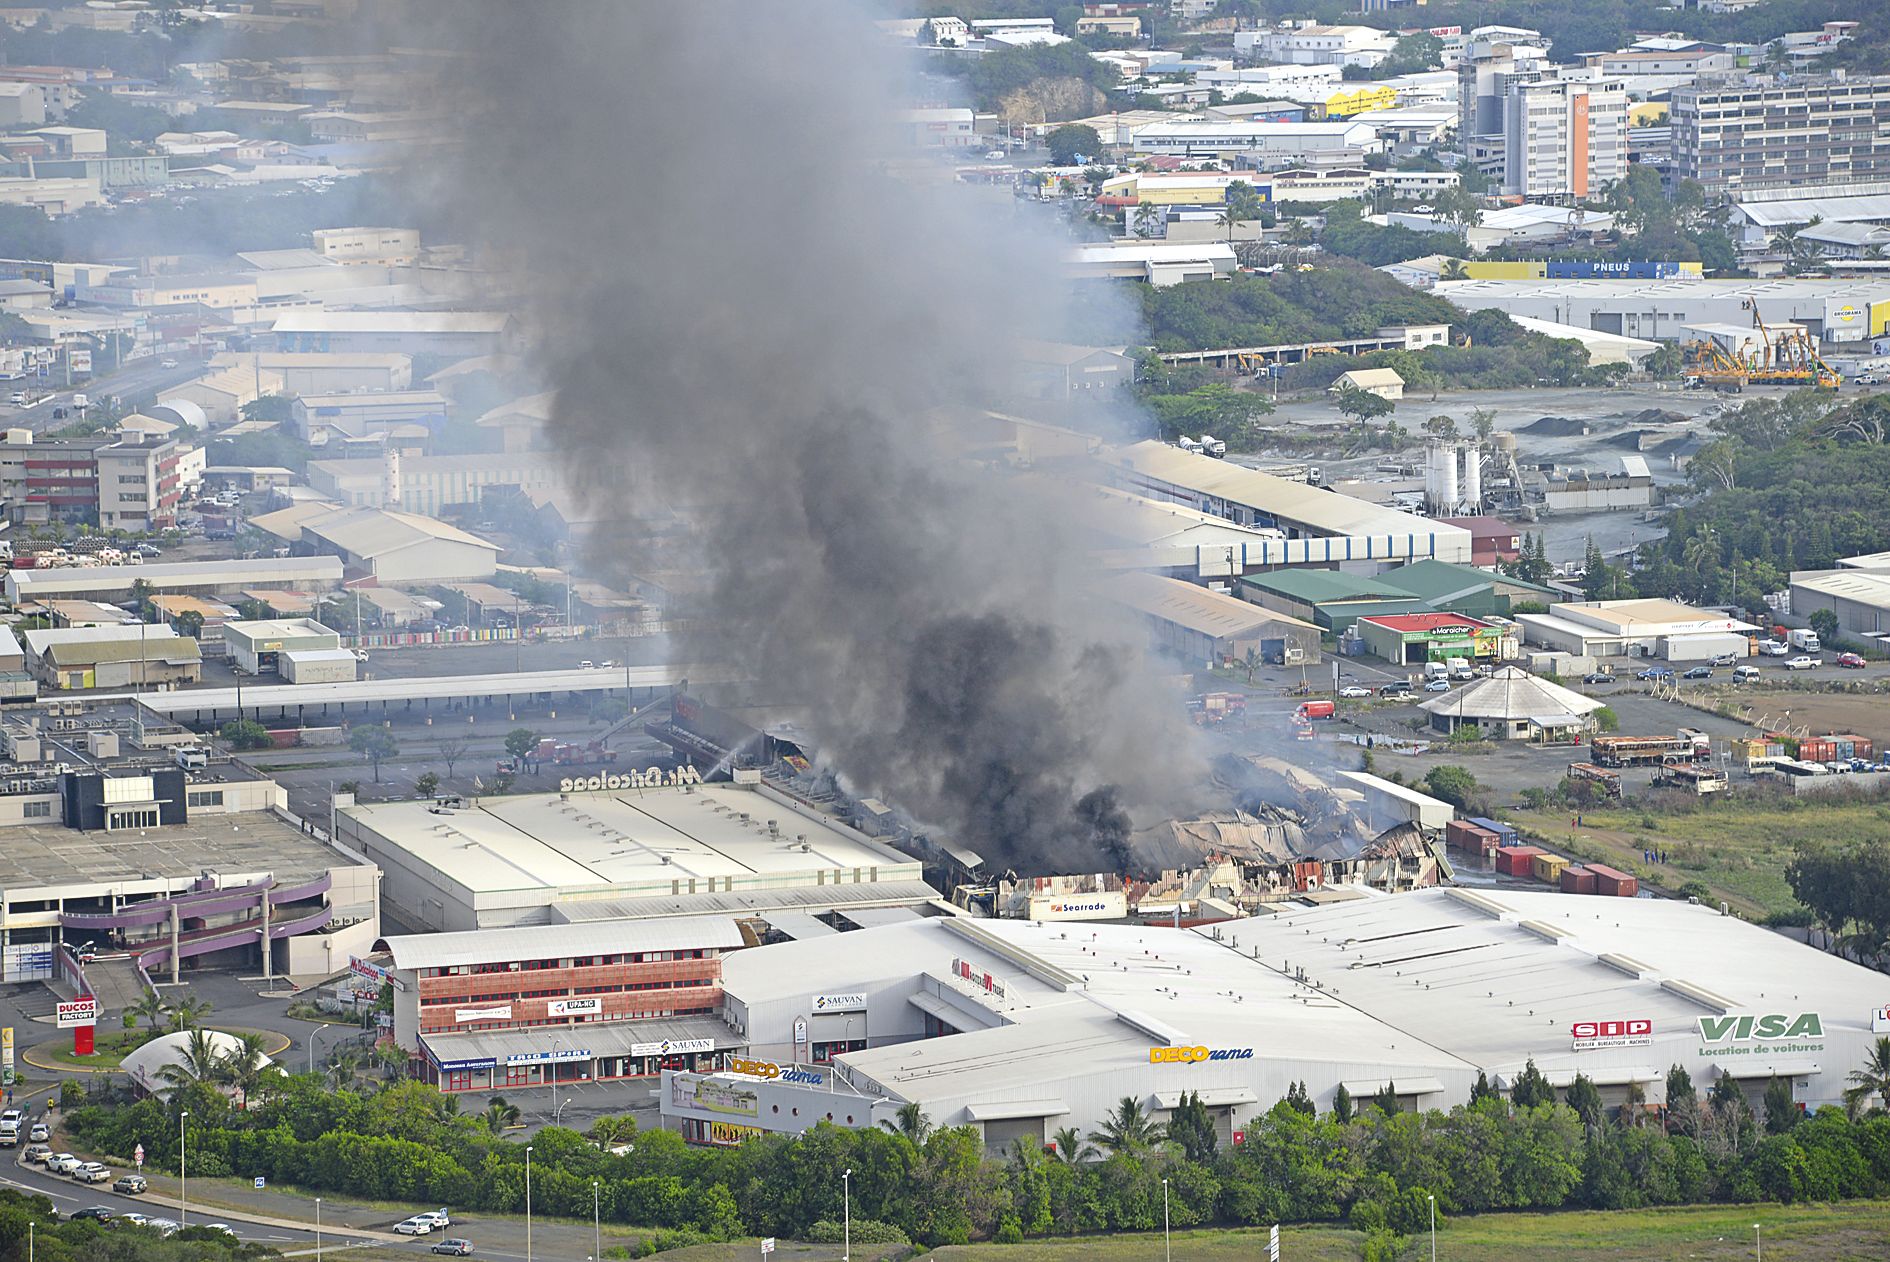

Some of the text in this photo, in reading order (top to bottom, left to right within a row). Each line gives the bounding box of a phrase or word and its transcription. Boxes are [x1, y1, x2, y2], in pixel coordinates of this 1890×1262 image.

[1593, 263, 1630, 272] PNEUS
[1063, 902, 1106, 912] Seatrade
[569, 1000, 594, 1008] UPA-NC
[827, 995, 863, 1004] SAUVAN
[59, 1003, 94, 1012] DUCOS
[61, 1012, 93, 1020] FACTORY
[1699, 1013, 1823, 1040] VISA
[672, 1040, 710, 1049] SAUVAN
[1699, 1043, 1824, 1056] Location de voitures
